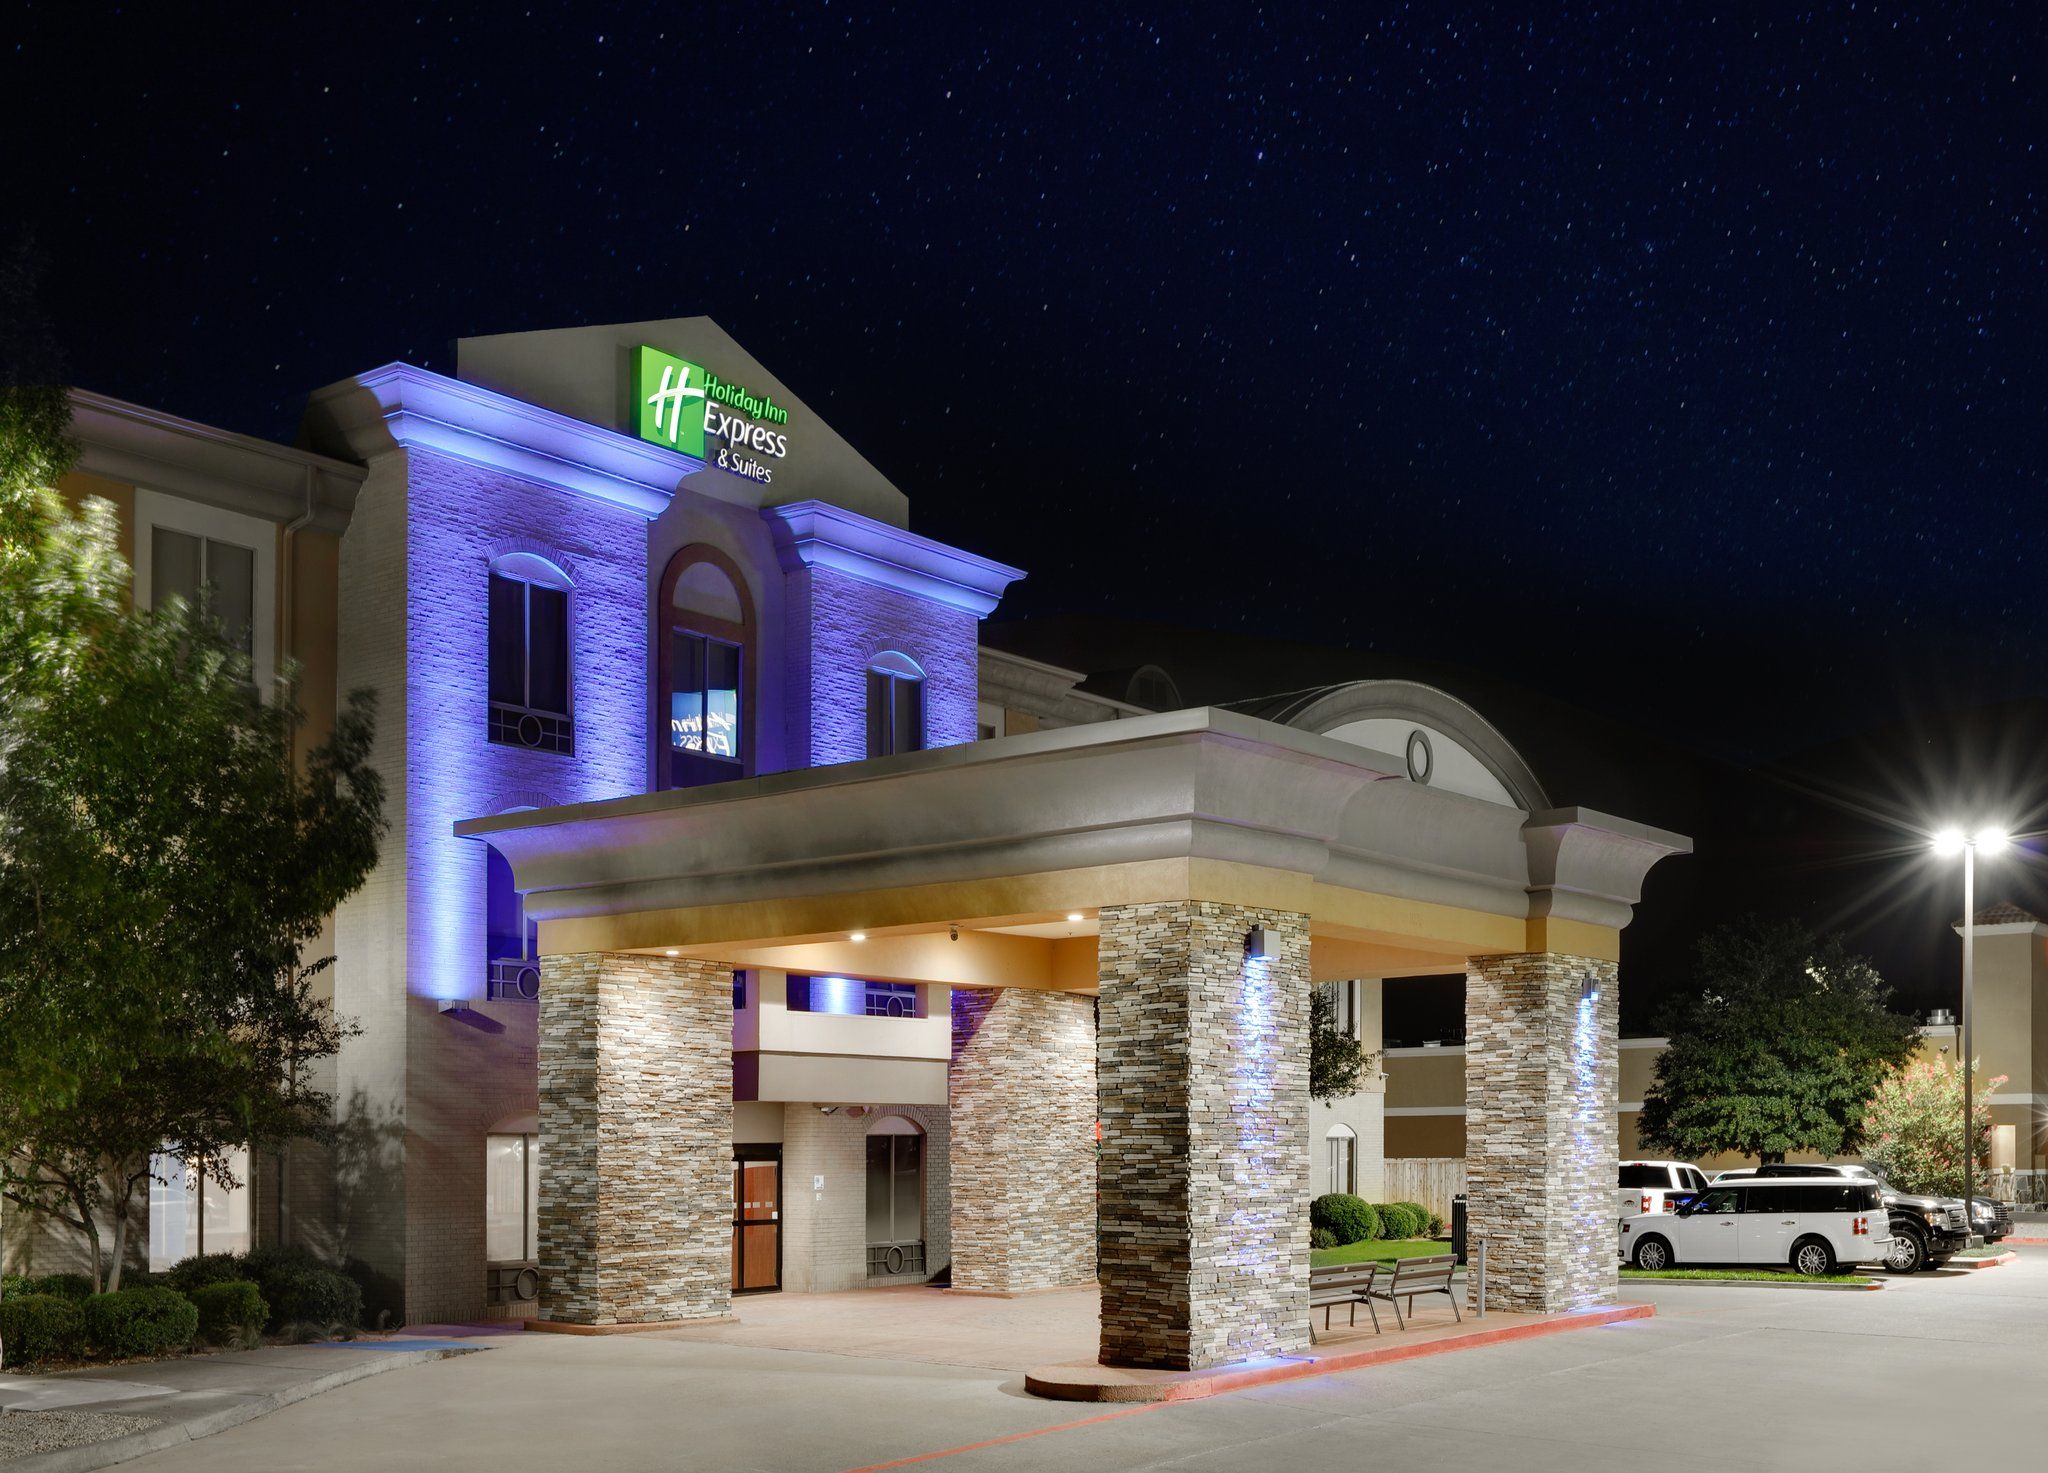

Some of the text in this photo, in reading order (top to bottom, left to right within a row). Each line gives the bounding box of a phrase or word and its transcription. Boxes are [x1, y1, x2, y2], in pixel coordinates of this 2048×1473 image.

[704, 373, 788, 425] Holiday Inn
[703, 401, 787, 458] Express
[717, 448, 772, 483] & Suites
